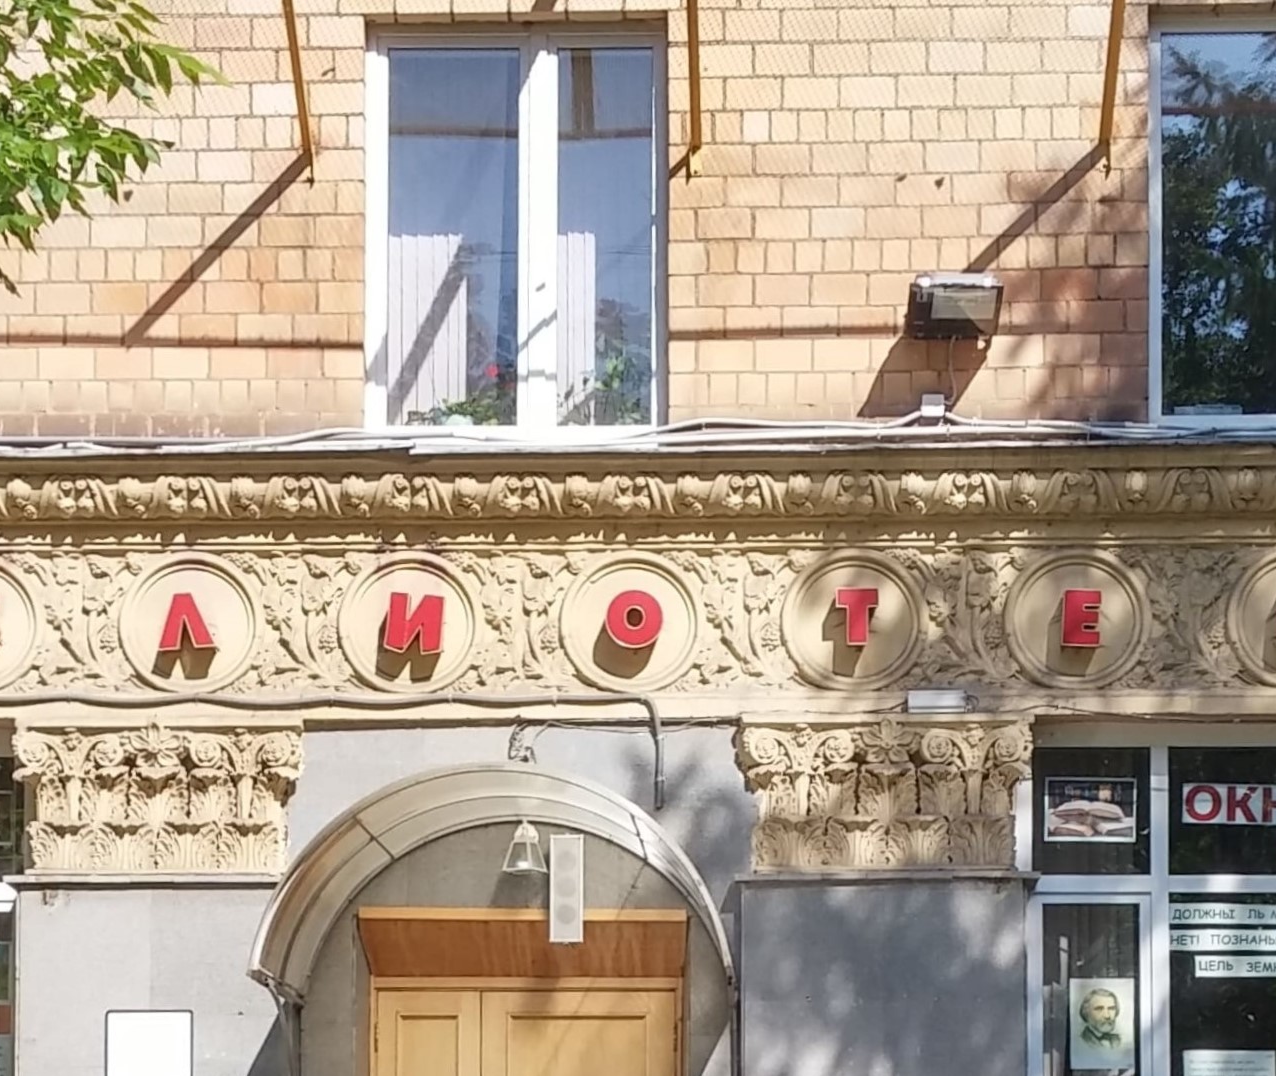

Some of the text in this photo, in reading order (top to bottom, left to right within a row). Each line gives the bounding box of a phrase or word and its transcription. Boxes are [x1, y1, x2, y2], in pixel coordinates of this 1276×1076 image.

[1172, 908, 1236, 921] ДОЛЖНЫ
[1247, 908, 1265, 920] ЛЬ
[1198, 960, 1234, 973] ЦЕЛЬ
